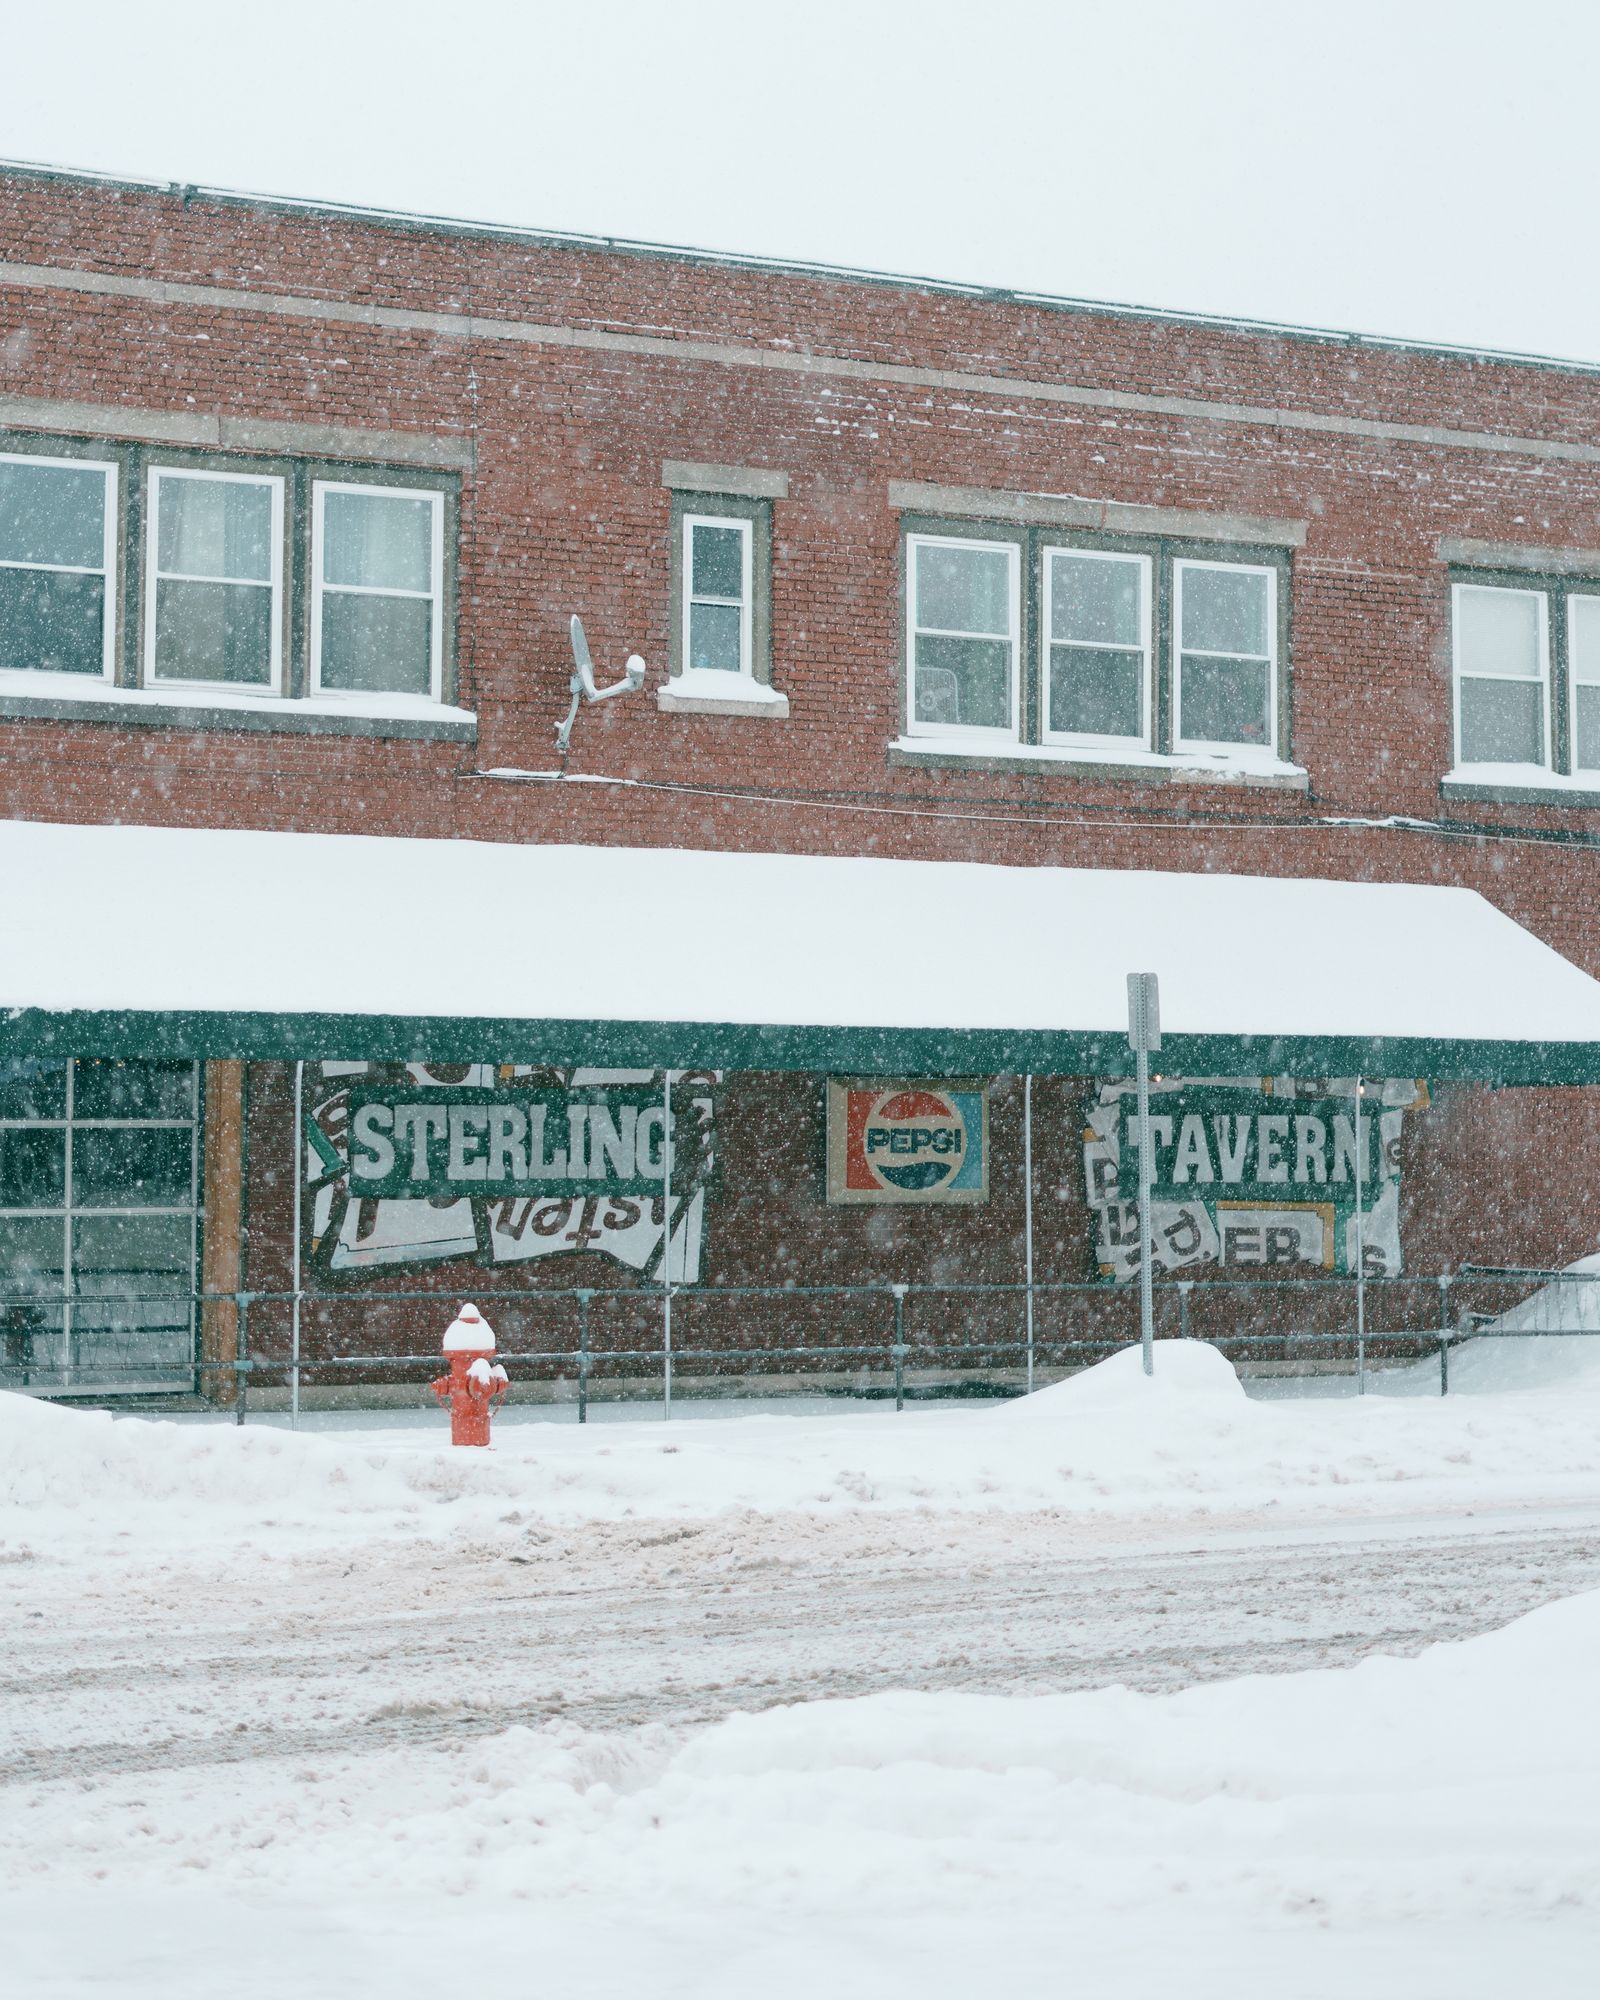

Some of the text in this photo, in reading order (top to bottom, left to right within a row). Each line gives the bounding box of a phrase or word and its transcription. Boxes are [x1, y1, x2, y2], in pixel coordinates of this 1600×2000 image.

[352, 1104, 677, 1181] STERLING
[867, 1127, 962, 1154] PEPSI
[1128, 1114, 1372, 1184] TAVERN
